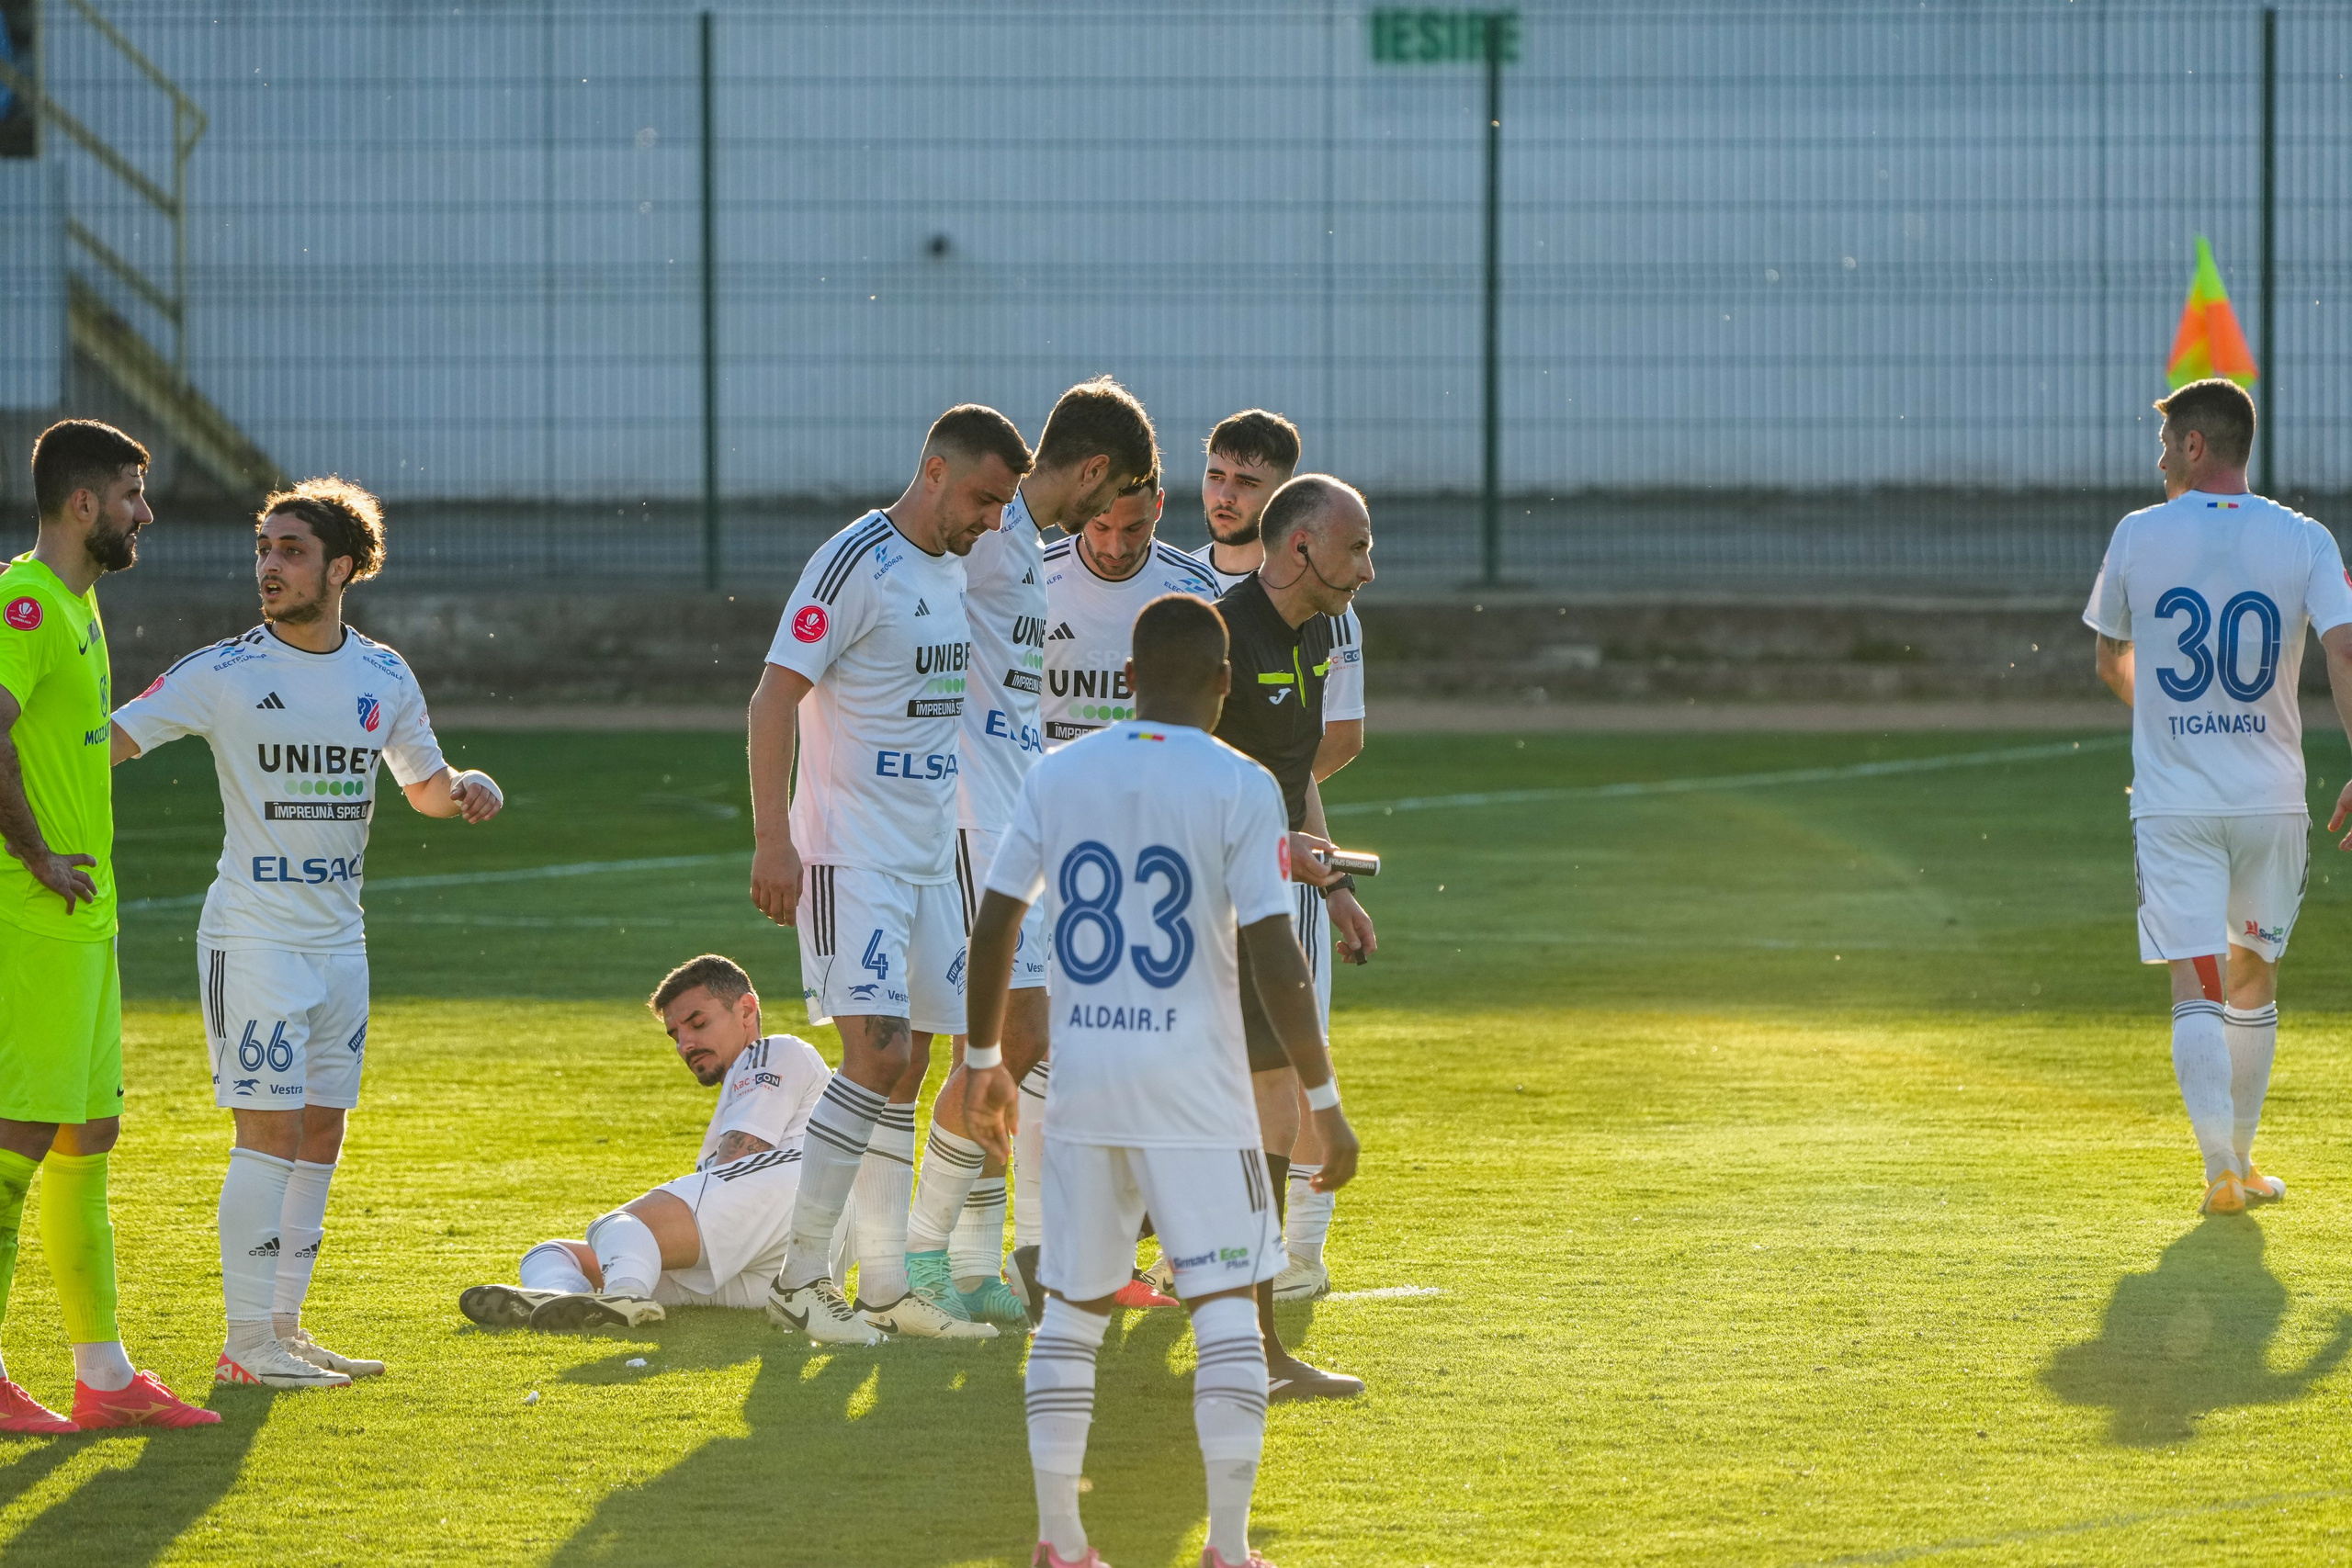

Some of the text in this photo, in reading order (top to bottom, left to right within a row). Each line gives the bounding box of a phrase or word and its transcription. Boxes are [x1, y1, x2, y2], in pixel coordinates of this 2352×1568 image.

[2154, 587, 2281, 703] 30
[273, 802, 334, 818] ÎMPREUNĂ
[336, 806, 360, 819] SPRE
[253, 854, 364, 885] ELSAC
[1056, 840, 1194, 989] 83
[861, 929, 889, 980] 4
[238, 1020, 294, 1073] 66
[269, 1084, 303, 1095] Vestra
[1220, 1247, 1248, 1261] Eco
